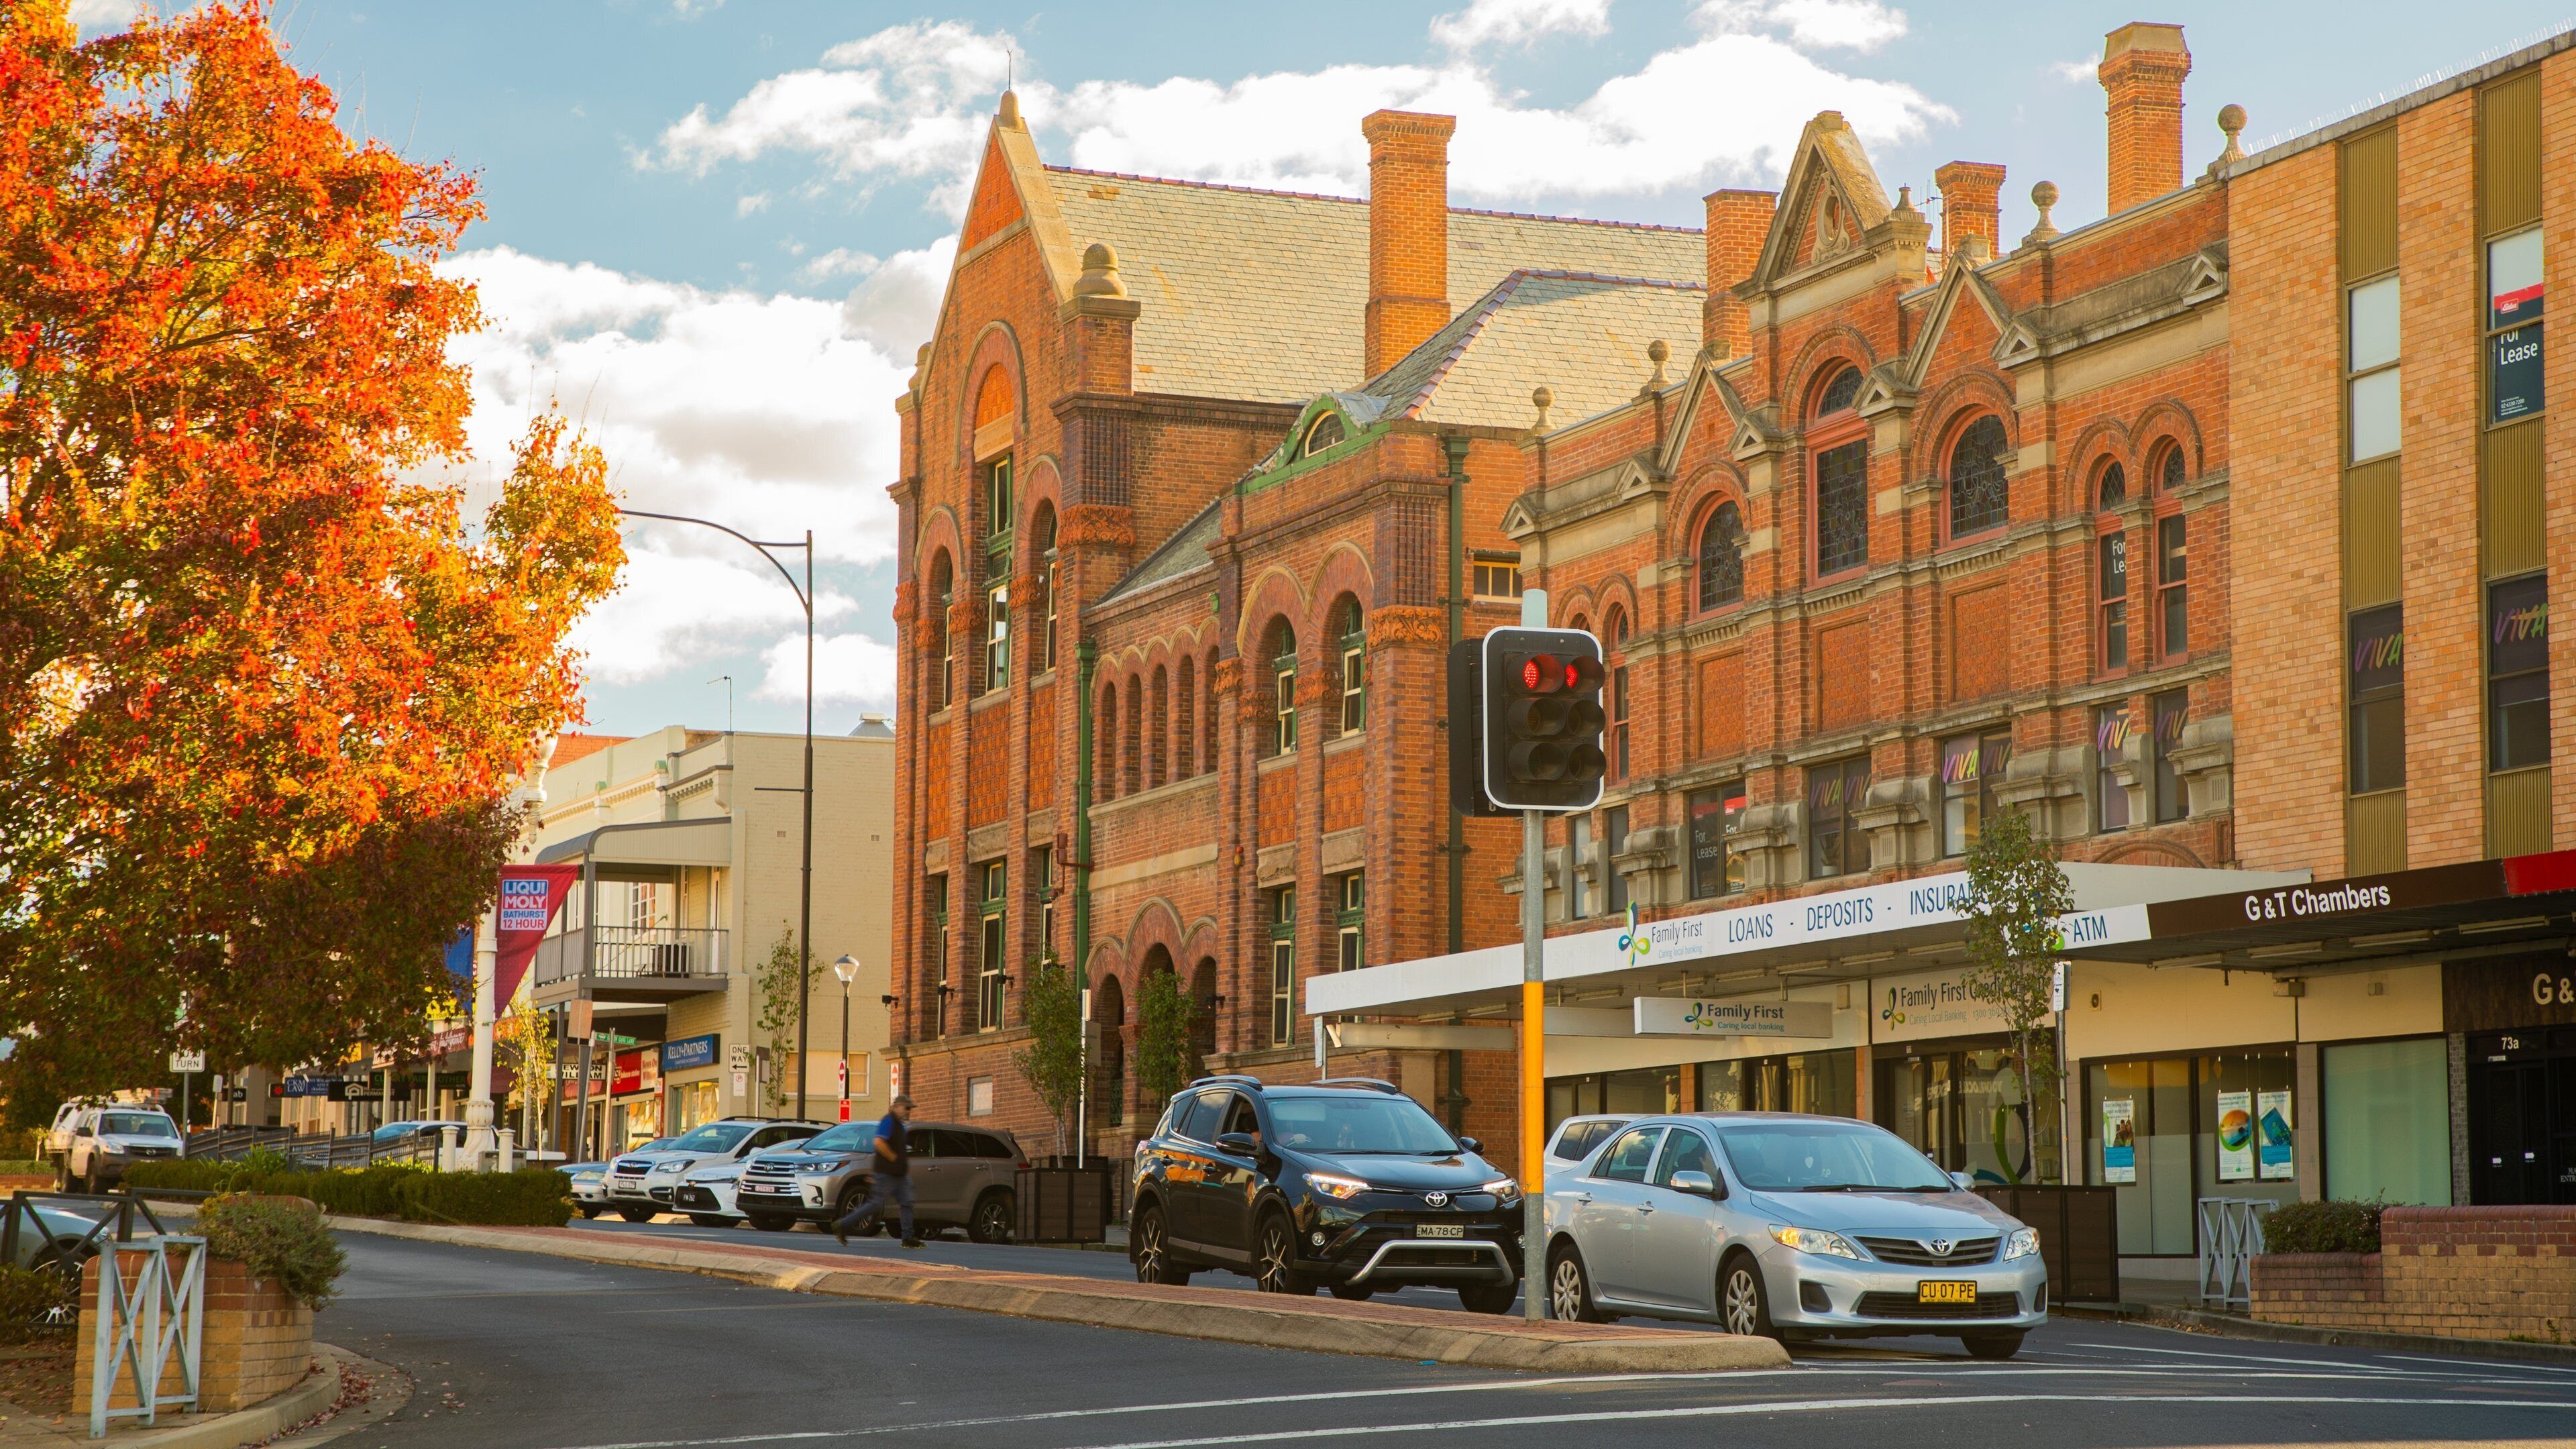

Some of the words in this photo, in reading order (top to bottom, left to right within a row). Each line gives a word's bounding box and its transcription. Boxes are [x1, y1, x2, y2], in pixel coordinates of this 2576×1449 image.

[2500, 342, 2538, 366] Lease
[2495, 602, 2548, 645] VIVA
[2355, 633, 2403, 672] VIVA
[2098, 717, 2131, 752] VIV
[1943, 749, 1979, 784] VIVA
[1810, 777, 1841, 810] VIVA
[1695, 829, 1707, 843] For
[1697, 846, 1718, 859] Lease
[505, 881, 546, 895] LIQUI
[504, 896, 546, 909] MOLY
[2292, 883, 2392, 916] Chambers
[503, 910, 545, 918] BATHURST
[1729, 913, 1774, 943] LOANS
[1807, 897, 1873, 931] DEPOSITS
[503, 919, 513, 928] 12
[515, 919, 545, 928] HOUR
[1652, 922, 1680, 945] Family
[1682, 920, 1703, 938] First
[2074, 915, 2108, 943] ATM
[1684, 944, 1703, 955] banking
[1901, 983, 1937, 1010] Family
[1941, 981, 1967, 1003] First
[1707, 1004, 1751, 1022] Family
[1754, 1005, 1784, 1019] First
[1909, 1013, 1927, 1027] Caring
[1928, 1011, 1943, 1024] Local
[1945, 1010, 1968, 1023] Banking
[1717, 1022, 1739, 1031] Caring
[1741, 1022, 1757, 1030] local
[1758, 1023, 1785, 1032] banking
[667, 1040, 708, 1060] KELLY+PARTNERS
[2501, 1036, 2520, 1051] 73a
[175, 1060, 199, 1068] TURN
[286, 1085, 305, 1093] LAW
